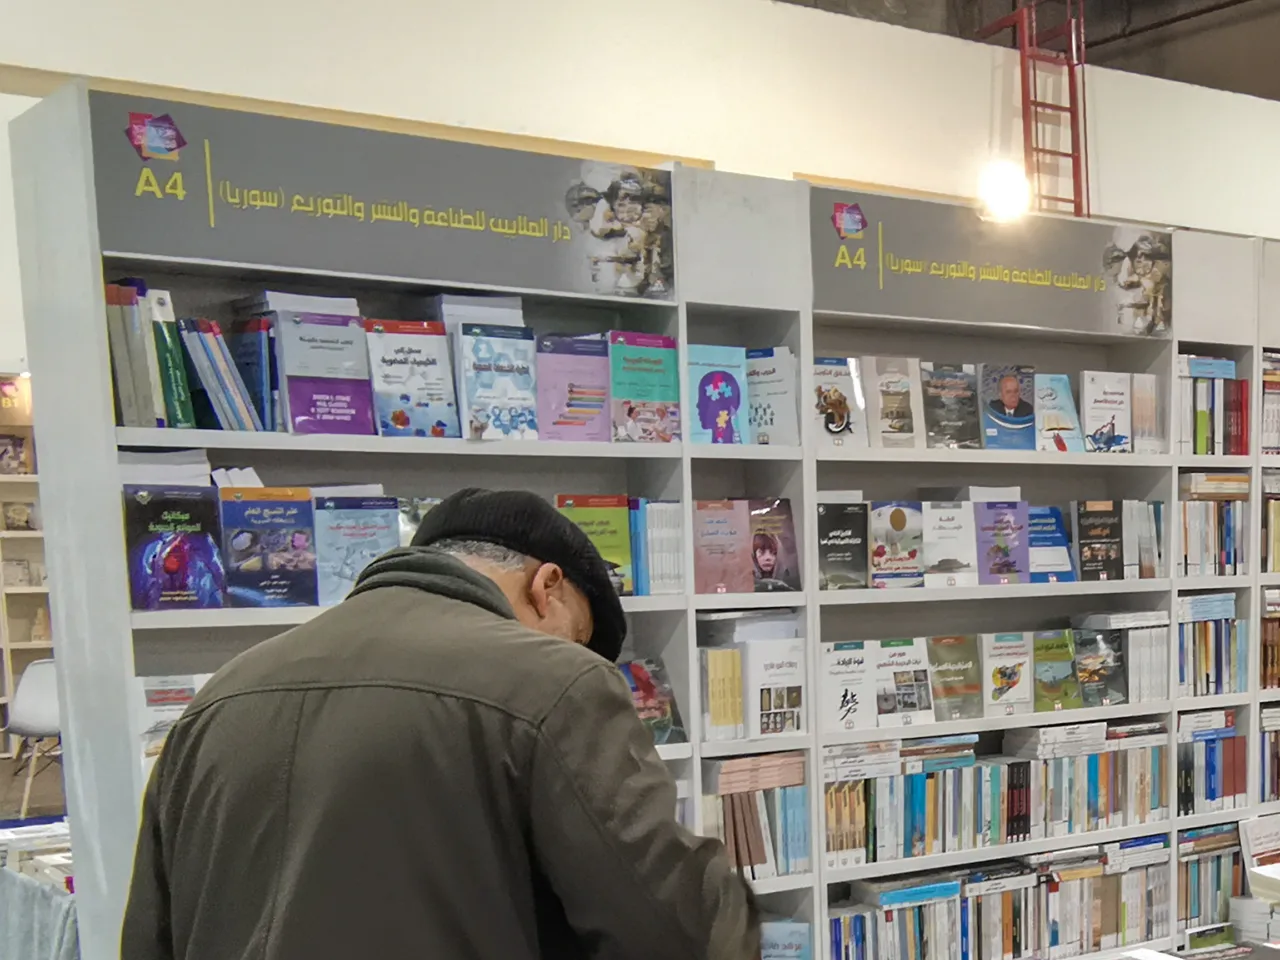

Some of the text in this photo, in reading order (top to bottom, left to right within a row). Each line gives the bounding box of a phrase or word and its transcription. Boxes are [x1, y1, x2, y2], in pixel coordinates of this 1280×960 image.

[135, 166, 187, 200] A4
[291, 192, 365, 222] والتوزيع
[370, 199, 420, 228] والنشر
[423, 204, 486, 231] للطباعة
[552, 220, 571, 243] دار
[834, 245, 867, 270] A4
